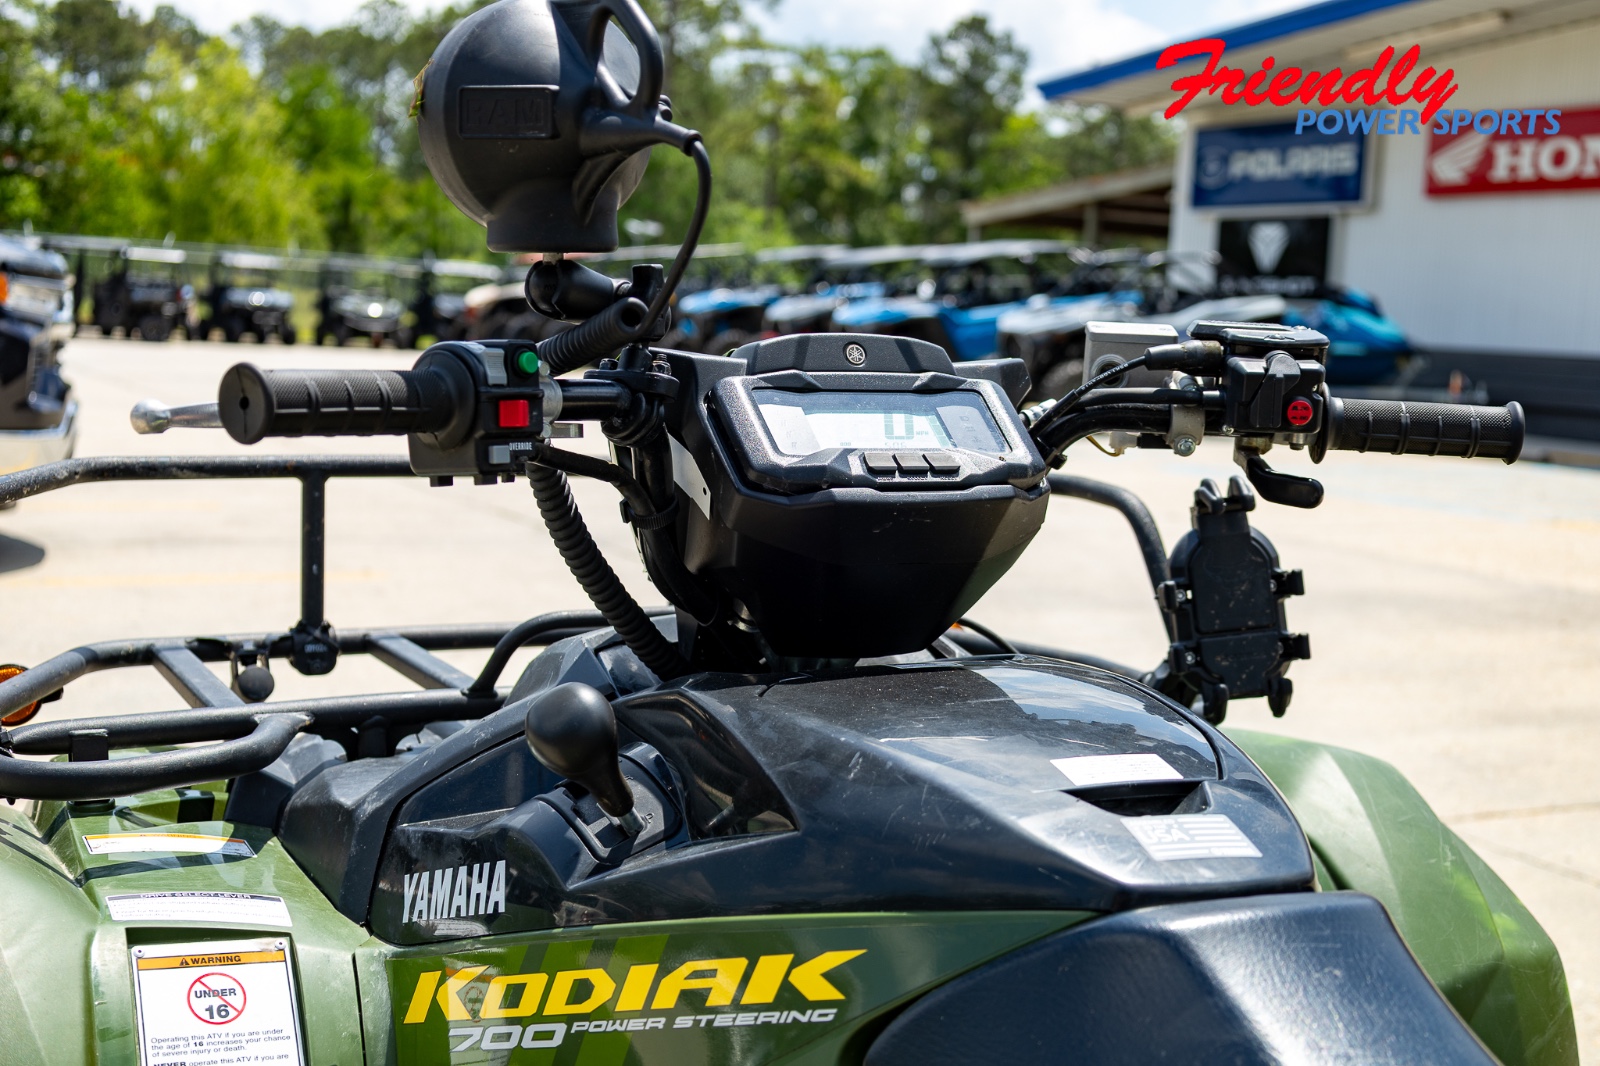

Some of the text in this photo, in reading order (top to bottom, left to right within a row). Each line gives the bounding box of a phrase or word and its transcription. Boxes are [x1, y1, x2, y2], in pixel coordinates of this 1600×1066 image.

[1136, 828, 1191, 843] USA
[402, 860, 506, 924] YAMAHA
[190, 955, 242, 965] WARNING
[194, 988, 237, 999] UNDER
[403, 949, 868, 1025] KODIAK
[205, 1004, 230, 1020] 16
[449, 1008, 838, 1052] 700 POWER STEERING
[151, 1036, 189, 1045] Operating
[206, 1032, 223, 1040] ATV
[231, 1031, 246, 1039] you
[206, 1039, 243, 1047] increases
[244, 1037, 261, 1045] your
[161, 1049, 188, 1057] severe
[190, 1047, 211, 1056] injury
[223, 1044, 247, 1052] death.
[260, 1055, 275, 1063] you
